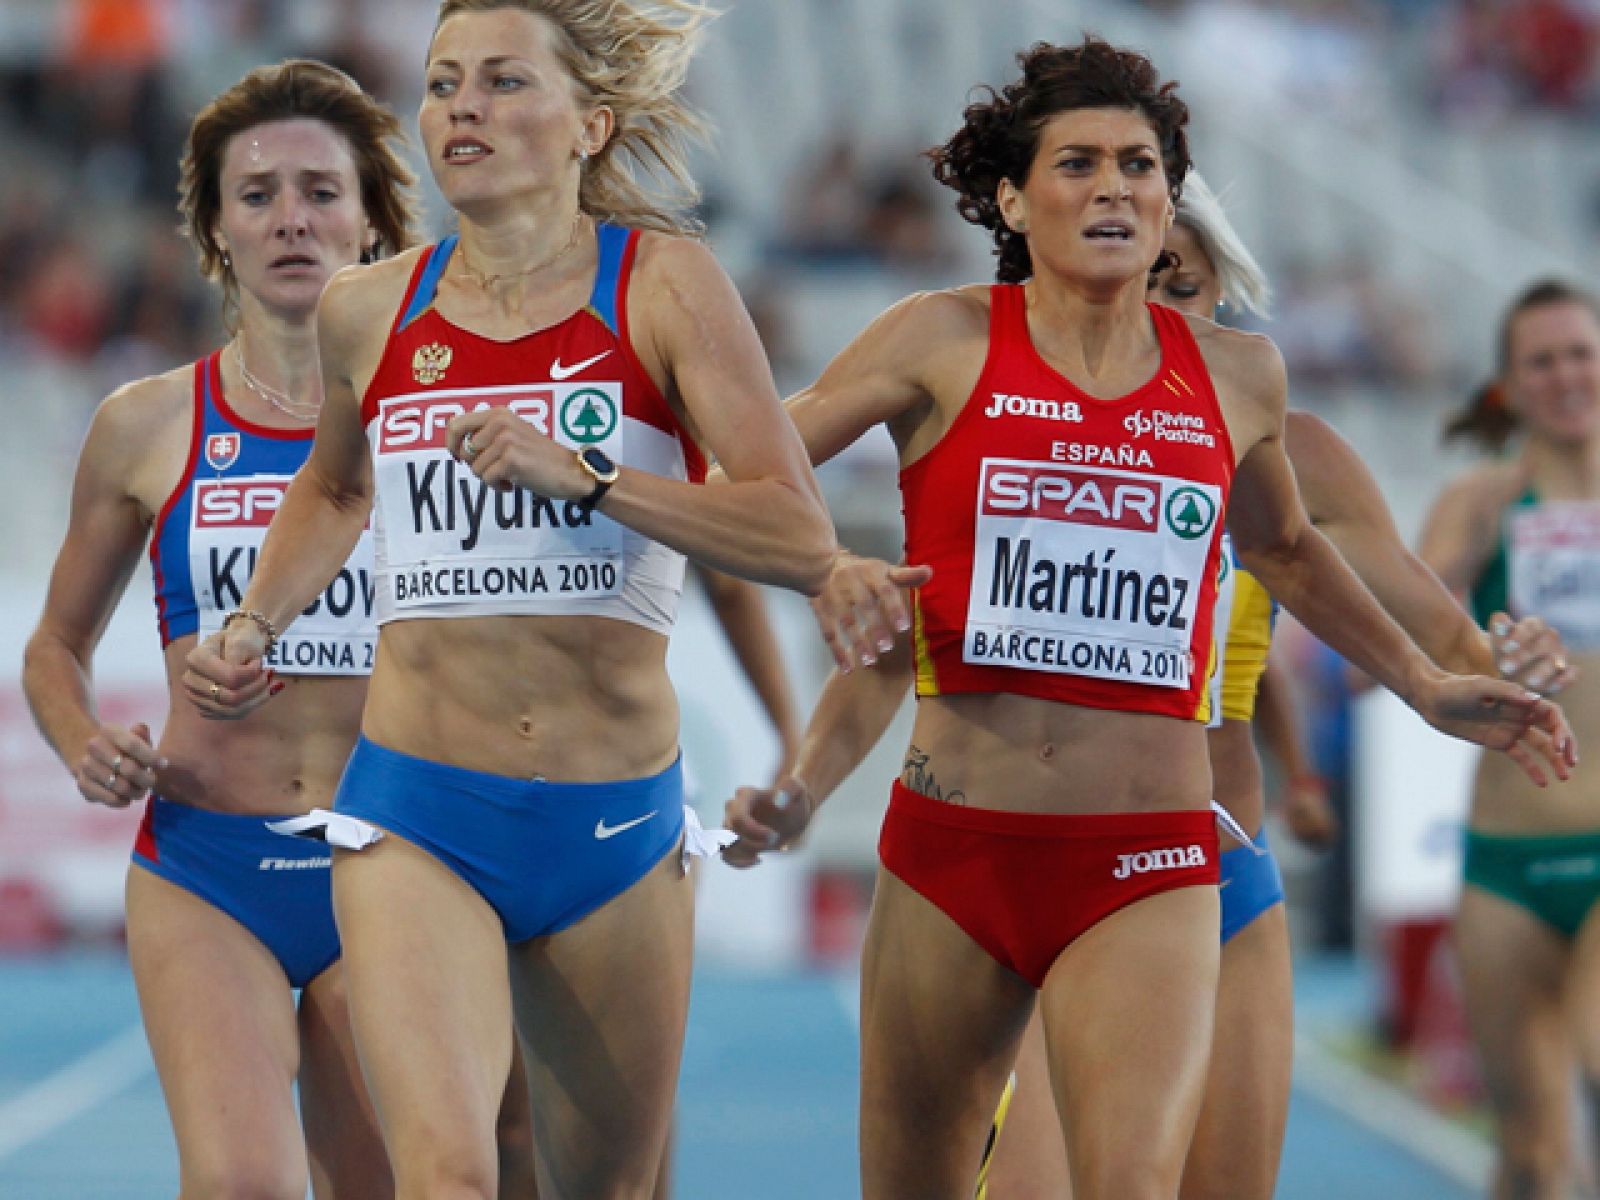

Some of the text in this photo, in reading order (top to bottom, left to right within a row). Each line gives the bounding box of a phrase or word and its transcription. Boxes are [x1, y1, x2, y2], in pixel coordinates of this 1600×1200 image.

[384, 400, 549, 446] SPR
[985, 393, 1083, 423] Joma
[1051, 441, 1153, 468] ESPAÑA
[201, 486, 286, 522] SP
[988, 471, 1157, 525] SPAR
[394, 561, 617, 601] BARCELONA 2010
[989, 536, 1190, 631] Martínez
[269, 639, 355, 667] ELONA
[972, 631, 1132, 674] BARCELONA
[1112, 844, 1207, 880] Joma
